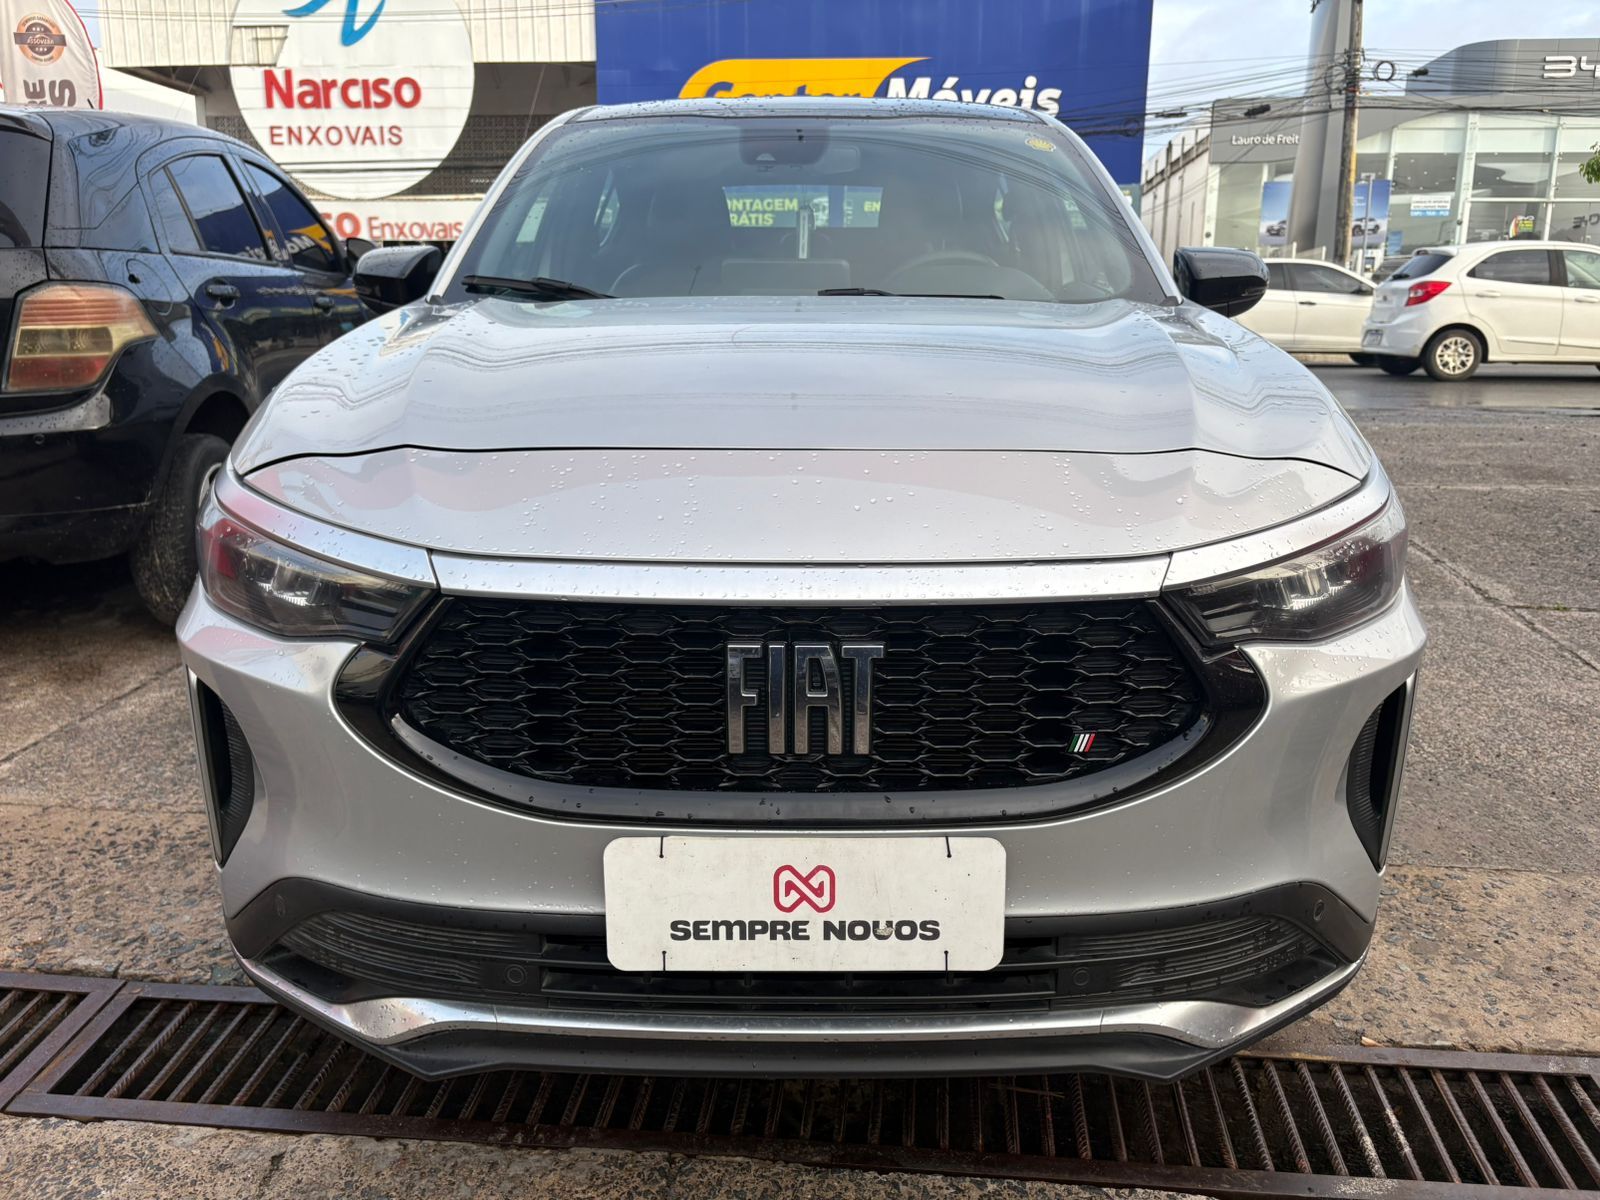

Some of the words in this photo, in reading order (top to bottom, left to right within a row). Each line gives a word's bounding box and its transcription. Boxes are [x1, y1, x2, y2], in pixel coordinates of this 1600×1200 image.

[264, 69, 421, 109] Narciso
[269, 125, 403, 146] ENXOVAIS
[1232, 135, 1261, 145] Lauro
[1262, 134, 1275, 145] de
[368, 216, 462, 240] Enxovais
[727, 644, 884, 754] FIAT
[670, 920, 810, 941] SEMPRE
